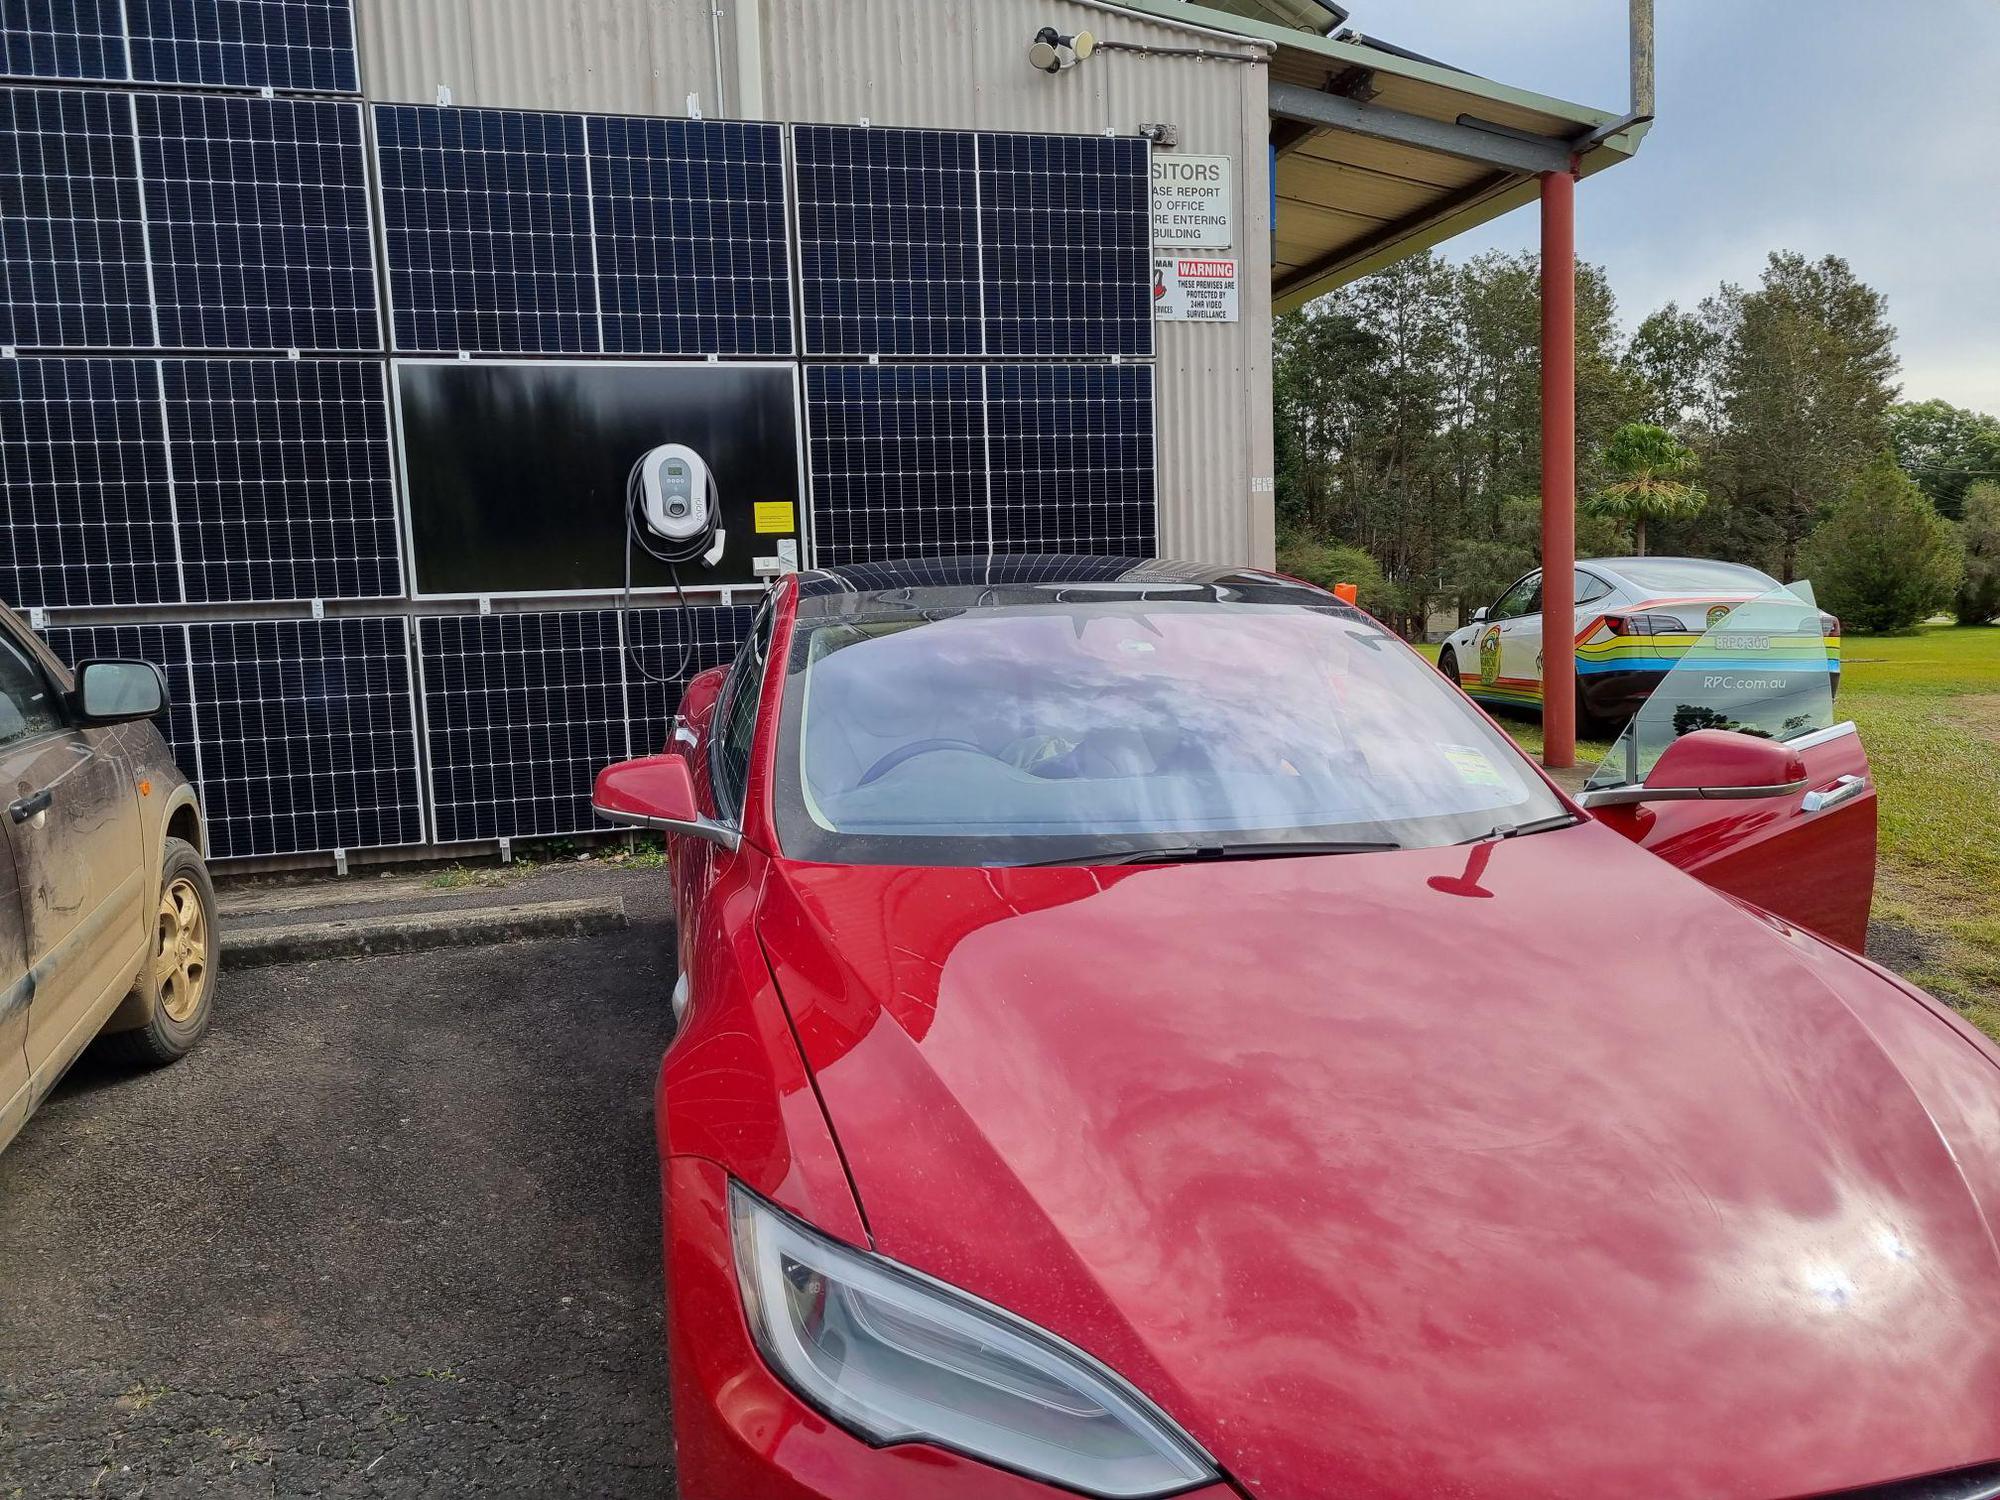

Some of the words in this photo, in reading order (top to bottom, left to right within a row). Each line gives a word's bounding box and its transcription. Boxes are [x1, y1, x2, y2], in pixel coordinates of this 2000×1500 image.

[1153, 162, 1220, 181] SITORS
[1177, 186, 1221, 197] REPORT
[1167, 200, 1205, 211] OFFICE
[1173, 214, 1226, 225] ENTERING
[1153, 228, 1201, 239] BUILDING
[1179, 262, 1233, 277] WARNING
[1178, 280, 1195, 288] THESE
[1196, 280, 1223, 289] PREMISES
[1224, 281, 1235, 290] ARE
[1186, 290, 1218, 299] PROTECTED
[1219, 291, 1226, 299] BY
[1190, 300, 1204, 309] 24HR
[1206, 300, 1222, 309] VIDEO
[1186, 310, 1227, 319] SURVEILLANCE
[1703, 676, 1787, 689] RPC.com.au
